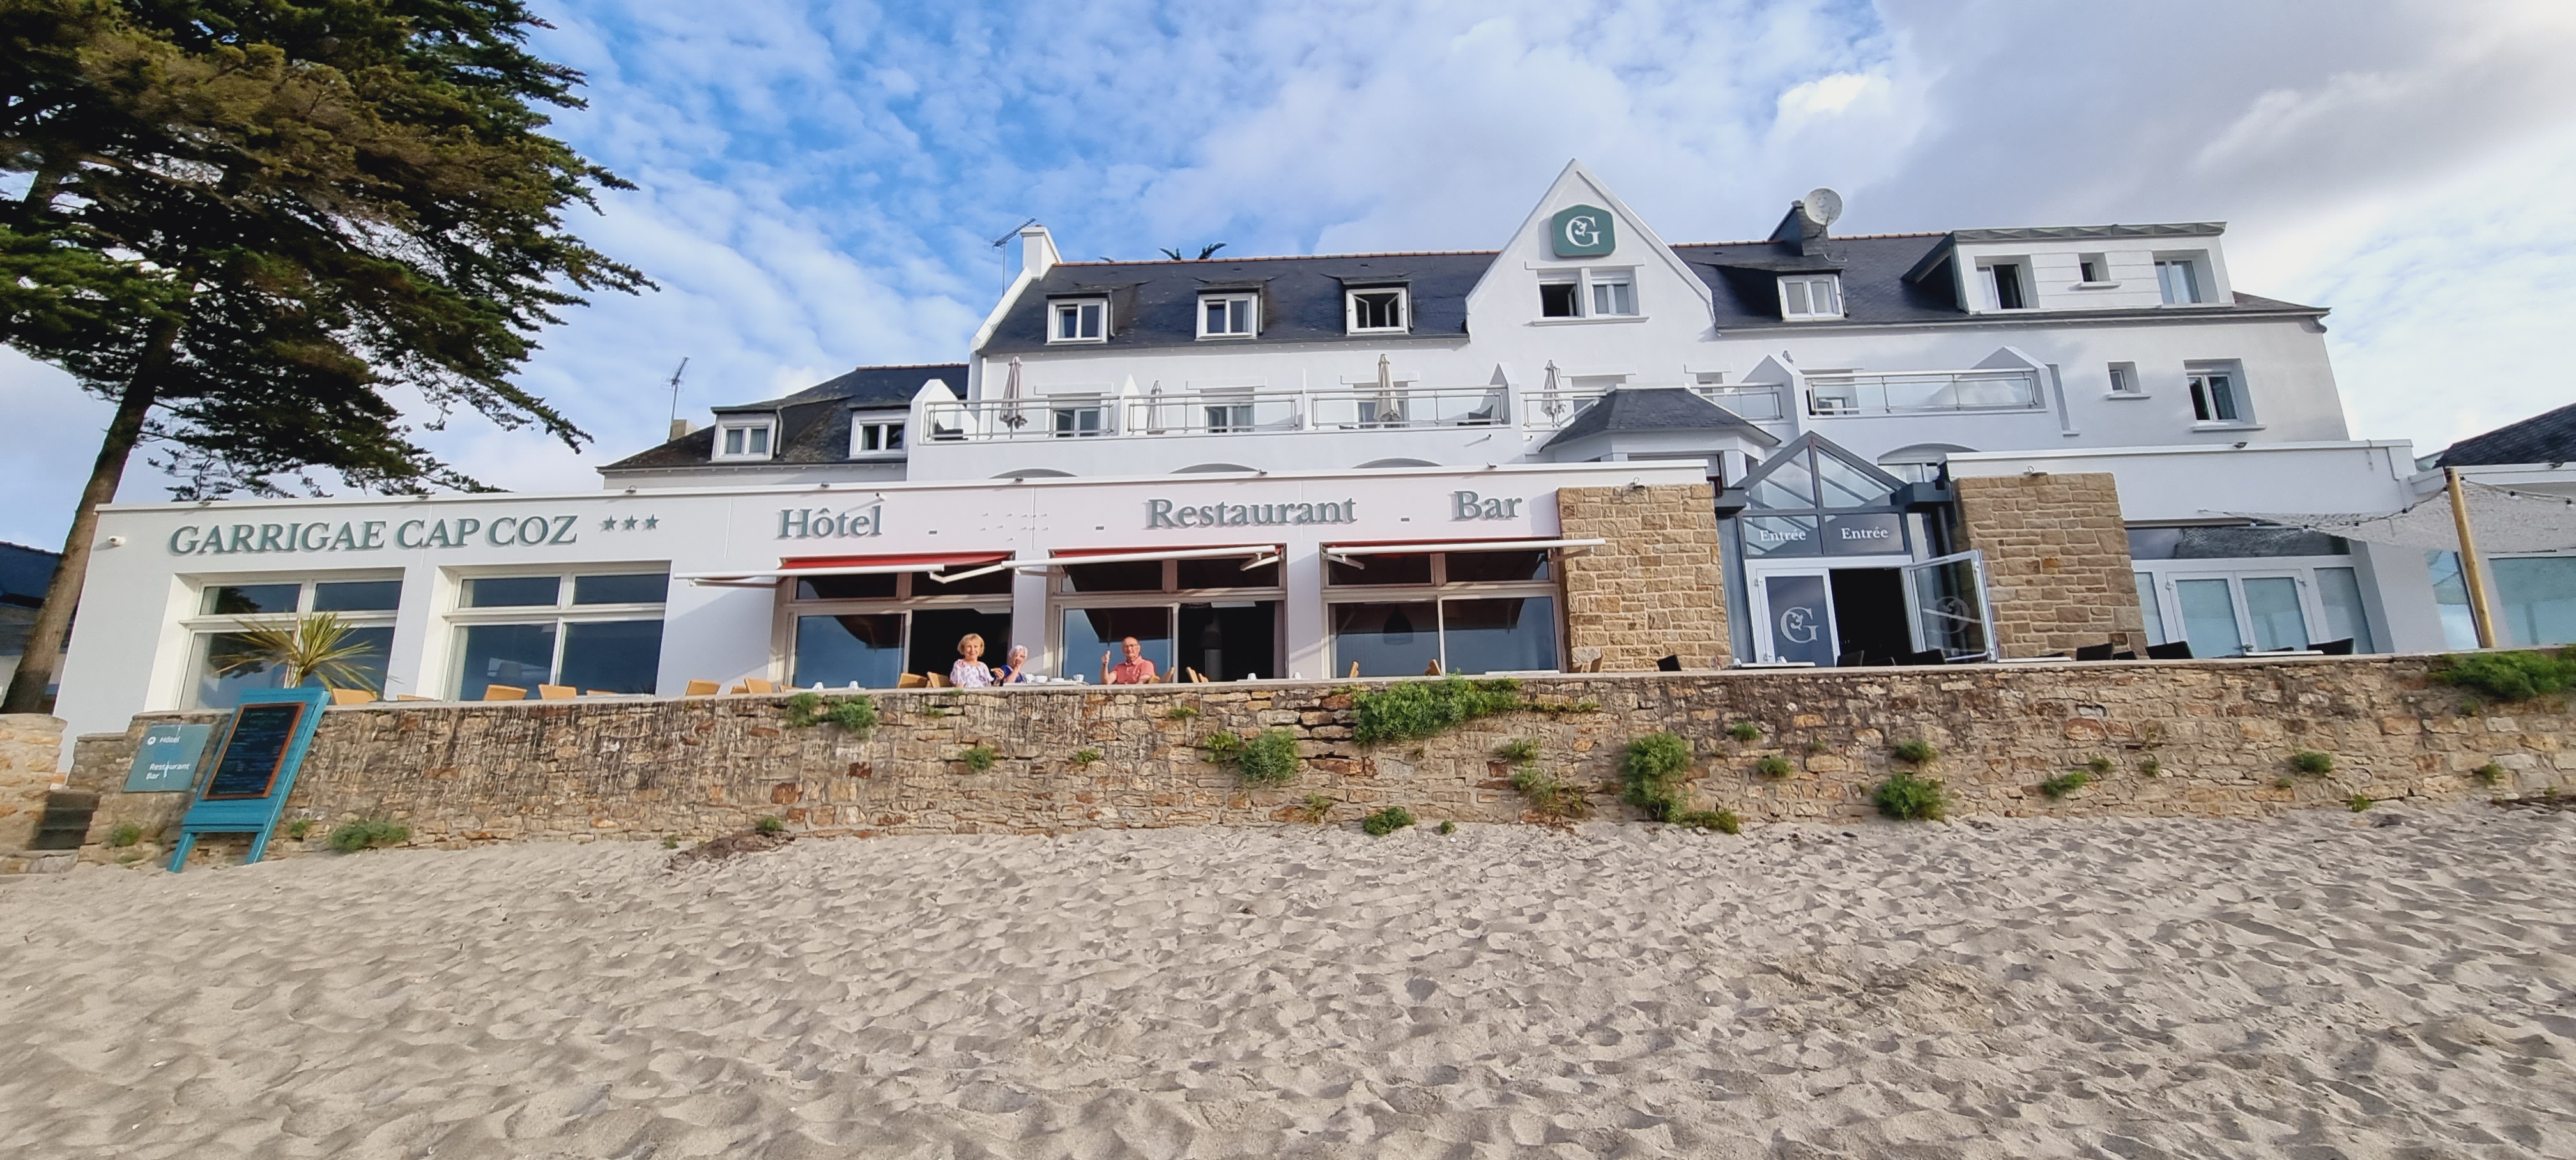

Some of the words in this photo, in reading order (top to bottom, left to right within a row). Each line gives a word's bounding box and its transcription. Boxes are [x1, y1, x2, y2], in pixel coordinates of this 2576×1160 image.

[778, 505, 882, 538] Hôtel
[1147, 498, 1358, 529] Restaurant
[1453, 491, 1522, 520] Bar
[169, 521, 387, 555] GARRIGAE
[397, 518, 480, 548] CAP
[489, 515, 578, 546] COZ
[1759, 528, 1807, 542] Entrée
[1841, 526, 1889, 540] Entrée
